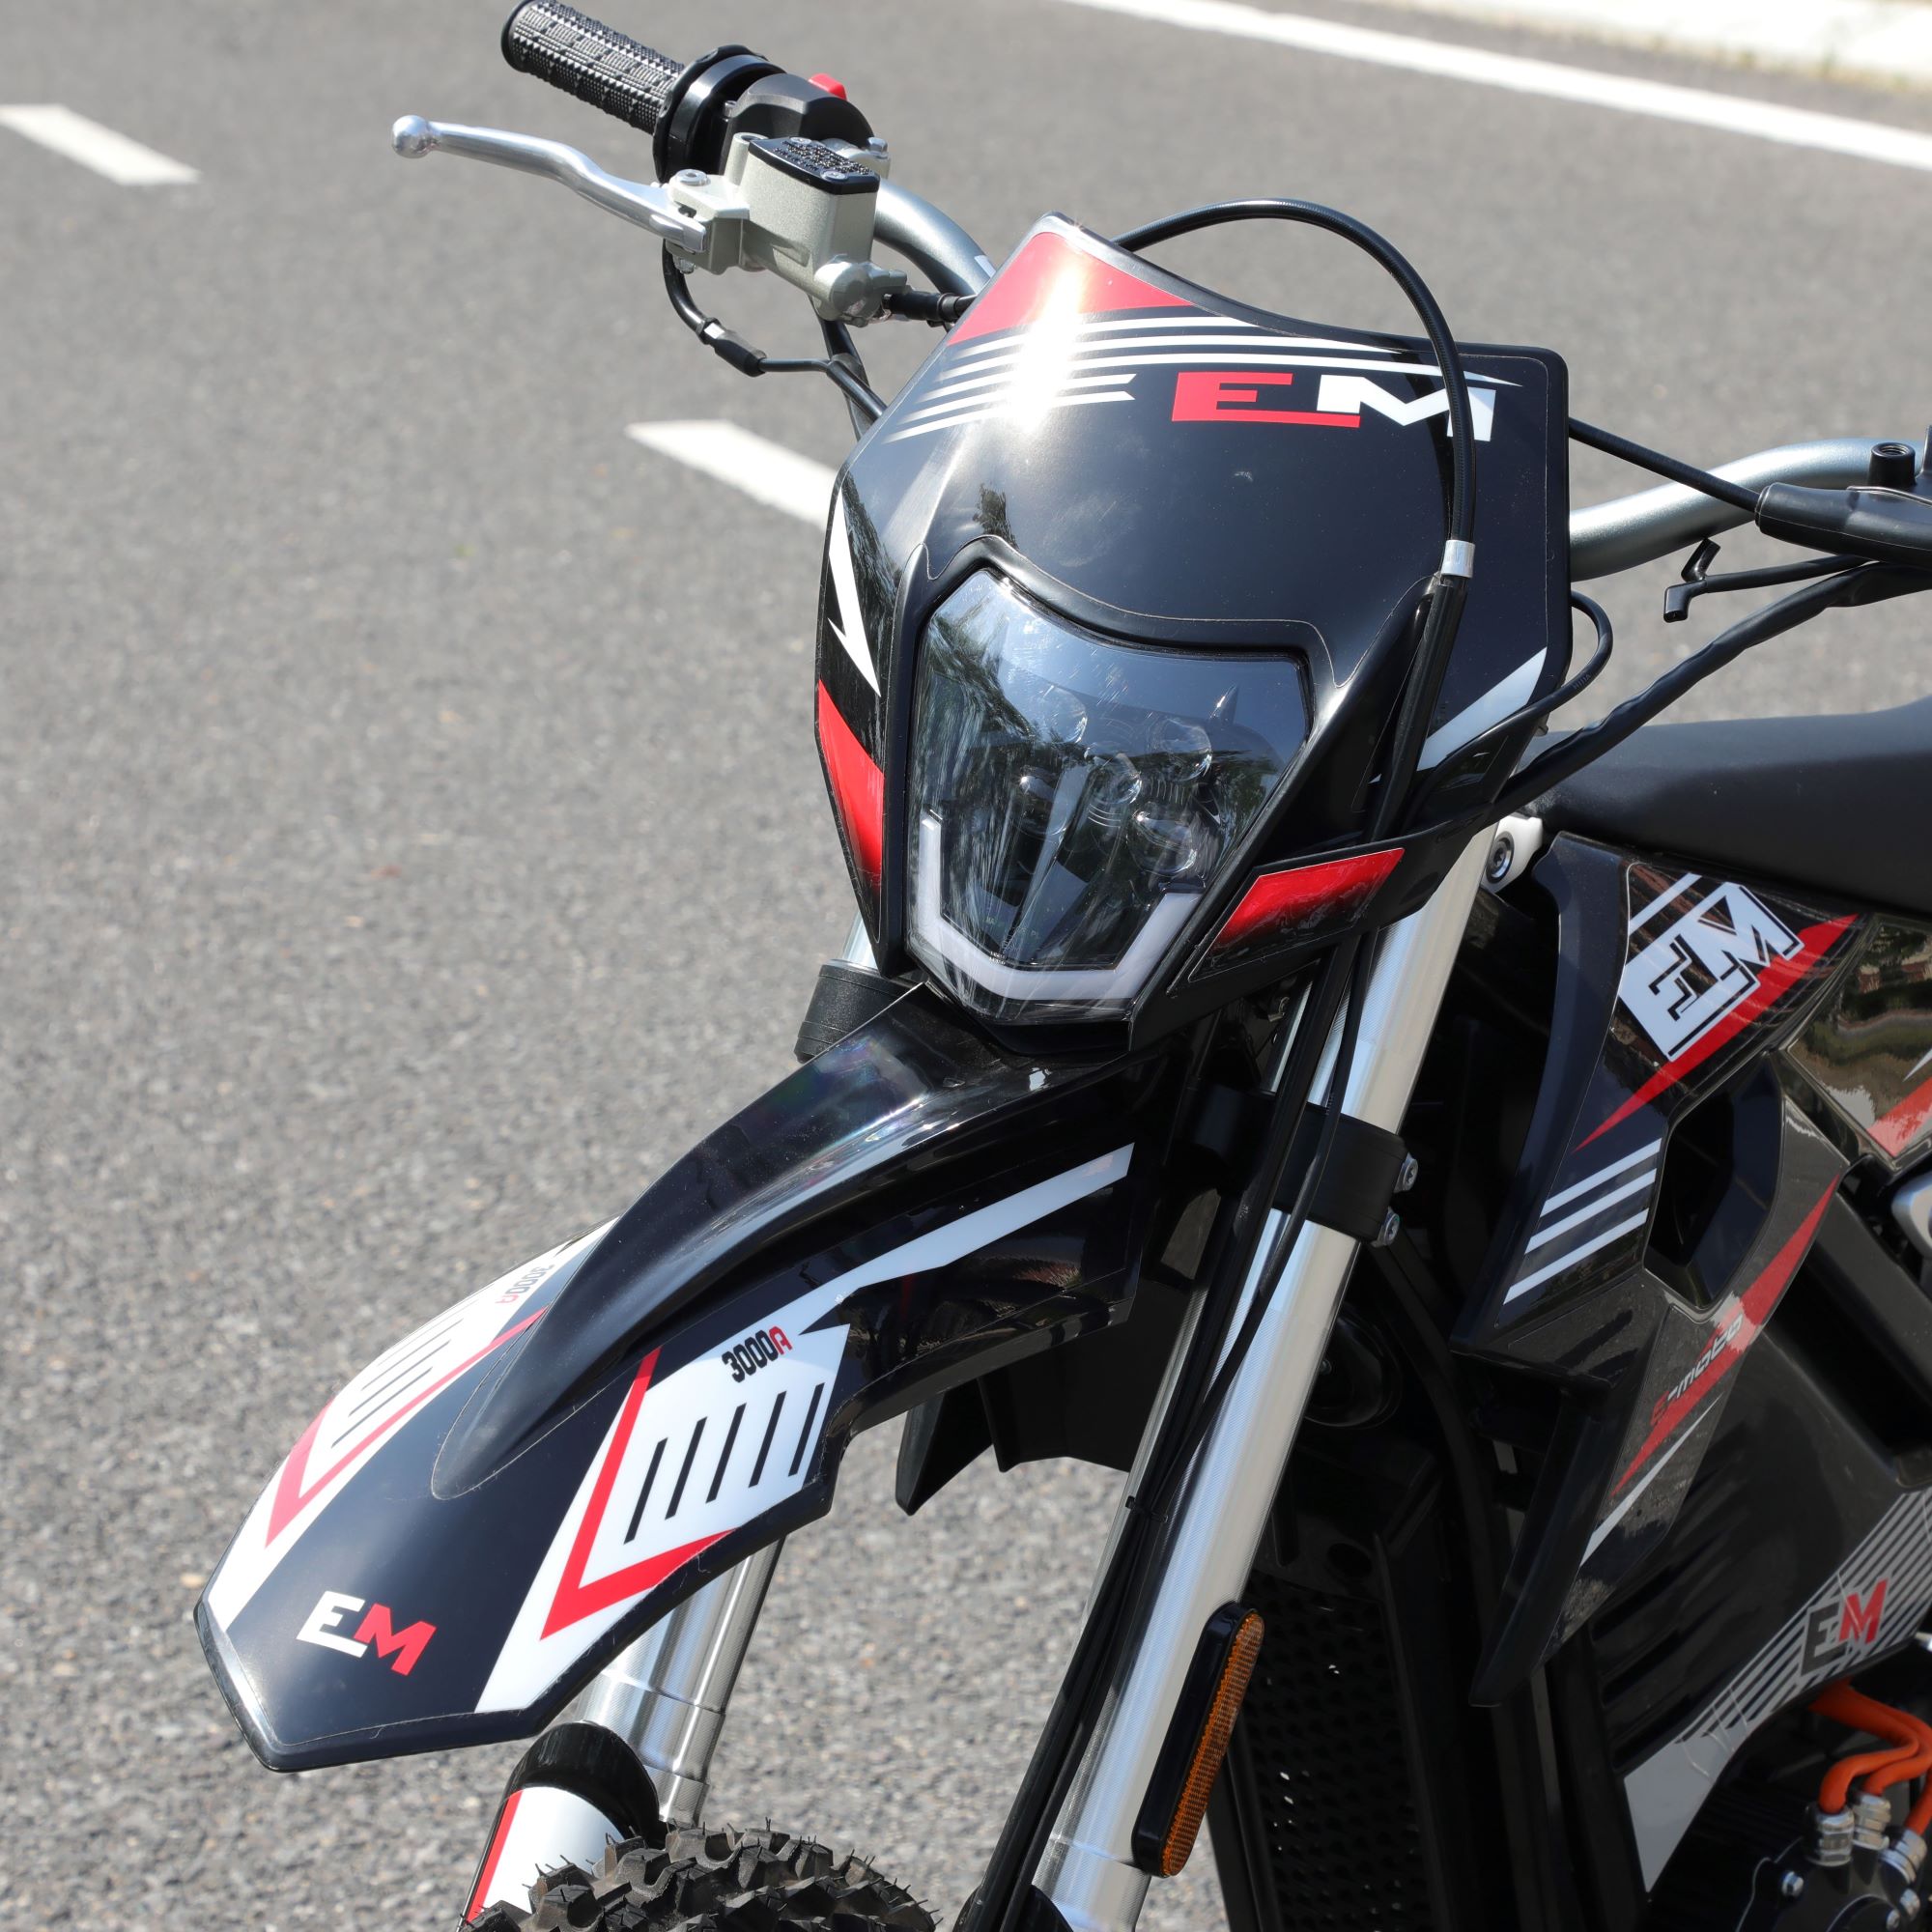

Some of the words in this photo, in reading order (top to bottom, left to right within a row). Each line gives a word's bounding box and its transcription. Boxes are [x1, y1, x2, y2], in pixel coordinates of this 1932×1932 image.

[1172, 372, 1496, 441] EM
[1618, 882, 1804, 1063] EM
[722, 1326, 793, 1383] 3000A
[296, 1590, 437, 1676] EM
[1801, 1577, 1889, 1677] EM
